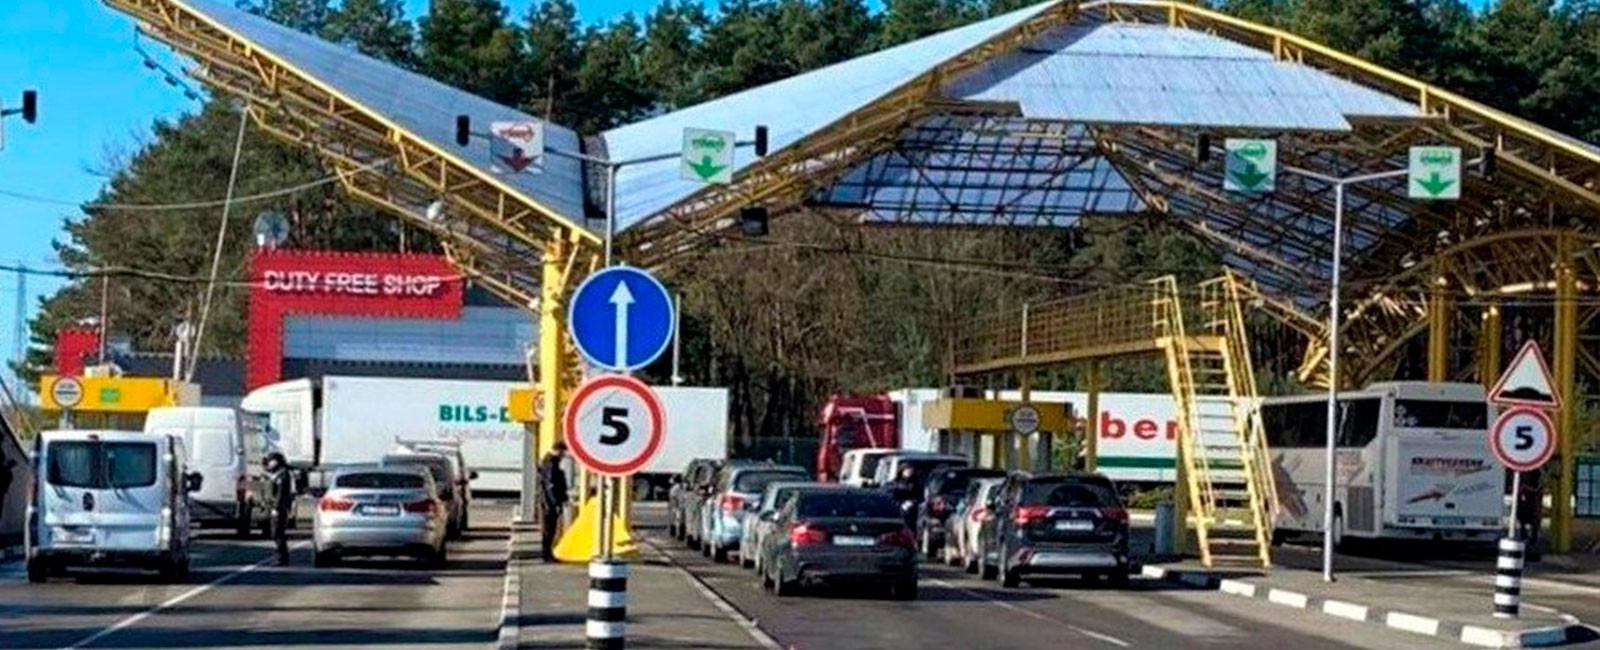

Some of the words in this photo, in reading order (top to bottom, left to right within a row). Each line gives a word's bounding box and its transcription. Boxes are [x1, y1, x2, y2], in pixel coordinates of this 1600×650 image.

[264, 271, 319, 291] DUTY
[325, 274, 377, 294] FREE
[384, 275, 441, 295] SHOP
[599, 408, 630, 445] 5
[1515, 427, 1534, 450] 5
